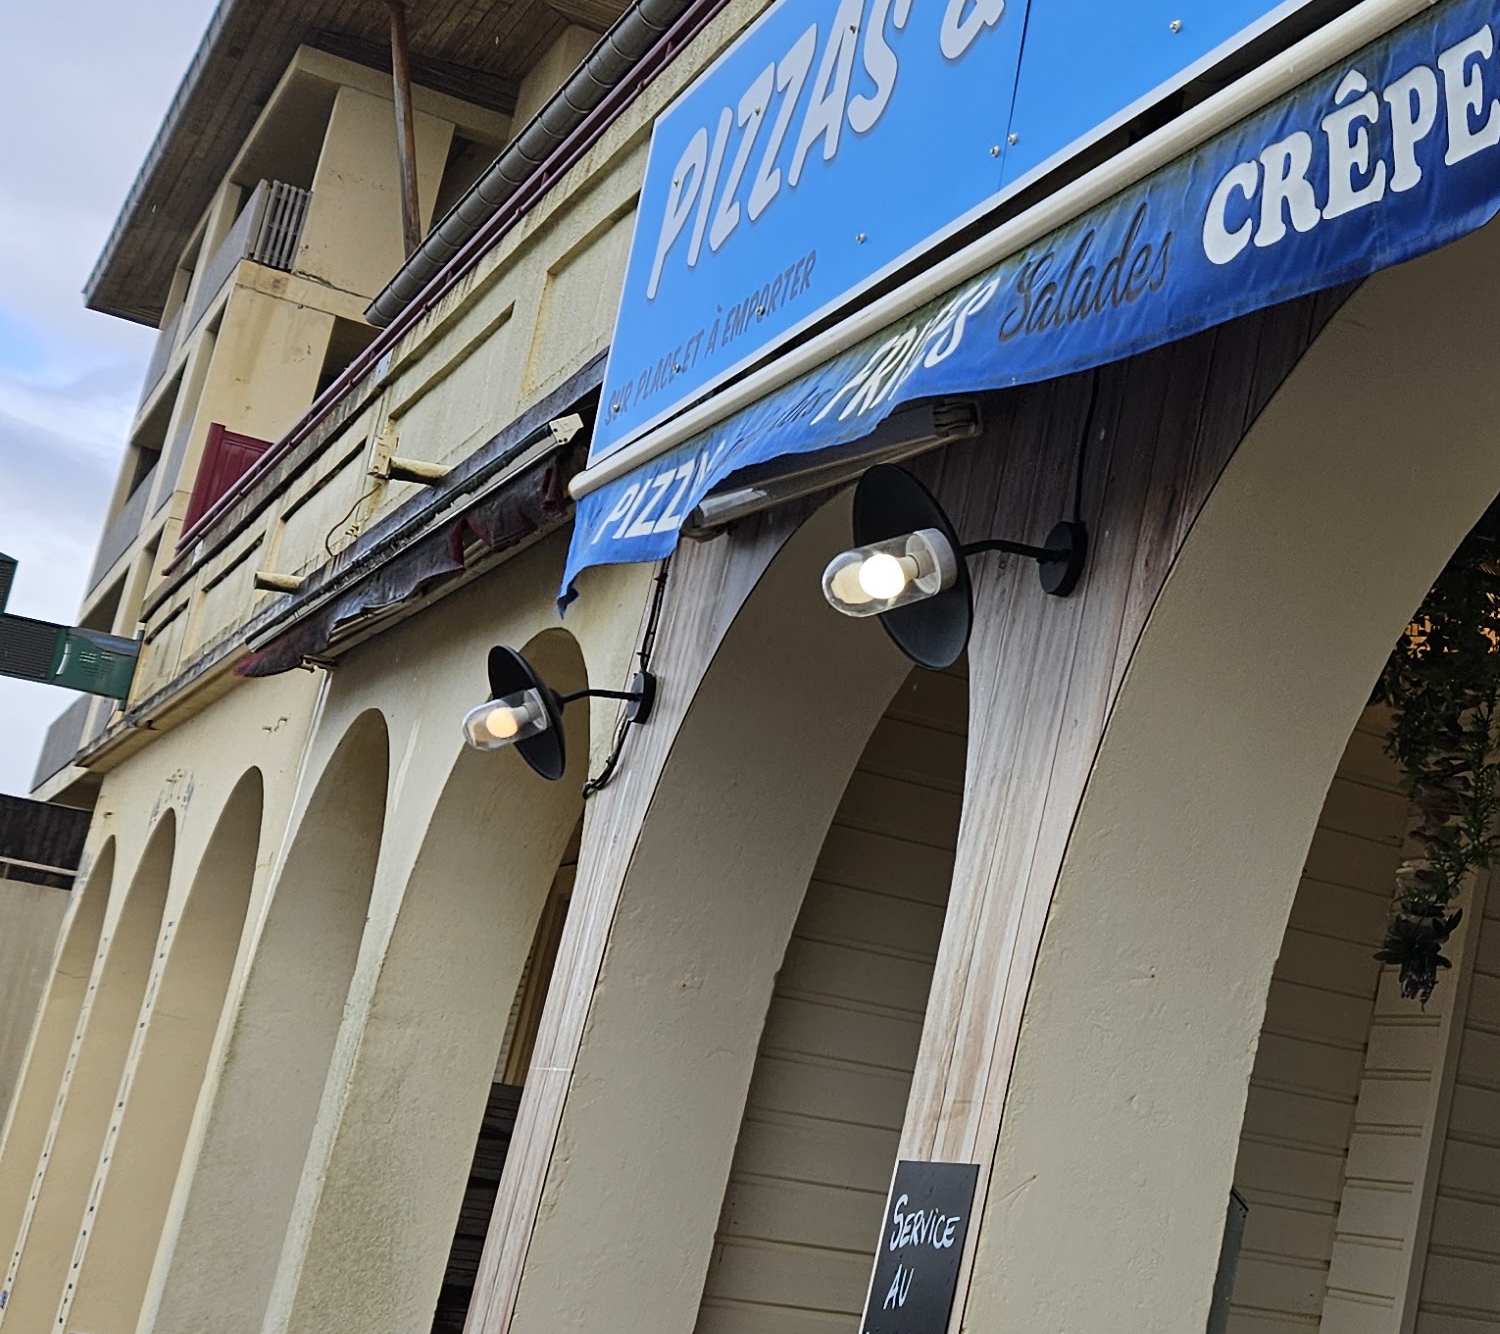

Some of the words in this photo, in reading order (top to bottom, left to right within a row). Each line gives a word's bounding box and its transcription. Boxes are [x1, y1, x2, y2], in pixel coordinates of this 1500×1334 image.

[605, 379, 634, 427] SUR
[633, 345, 683, 407] PLACE
[681, 328, 705, 375] ET
[721, 249, 817, 348] EMPORTER
[999, 201, 1175, 341] Salades
[883, 1263, 915, 1310] AU
